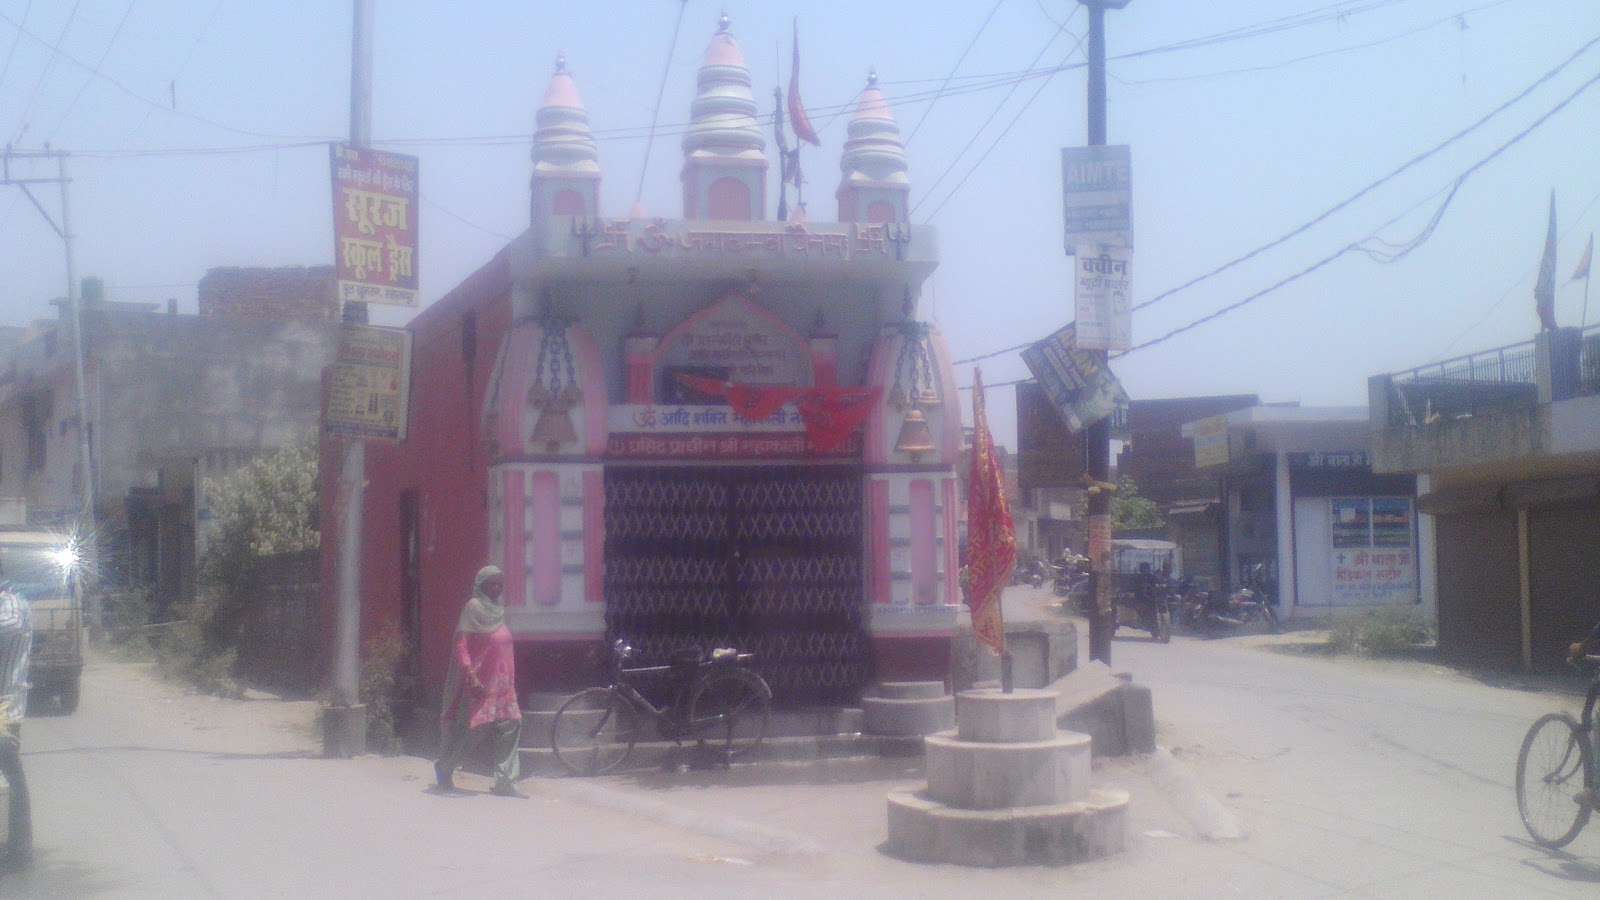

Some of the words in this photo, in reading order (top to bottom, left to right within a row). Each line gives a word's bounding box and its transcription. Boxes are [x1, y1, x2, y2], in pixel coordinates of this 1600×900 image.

[342, 187, 409, 235] सूरज
[341, 236, 384, 280] स्कूल
[385, 233, 414, 282] ड्रेस
[1080, 254, 1129, 277] क्वीन
[660, 408, 691, 427] आदि
[693, 408, 728, 426] शक्ति
[719, 437, 739, 454] श्री
